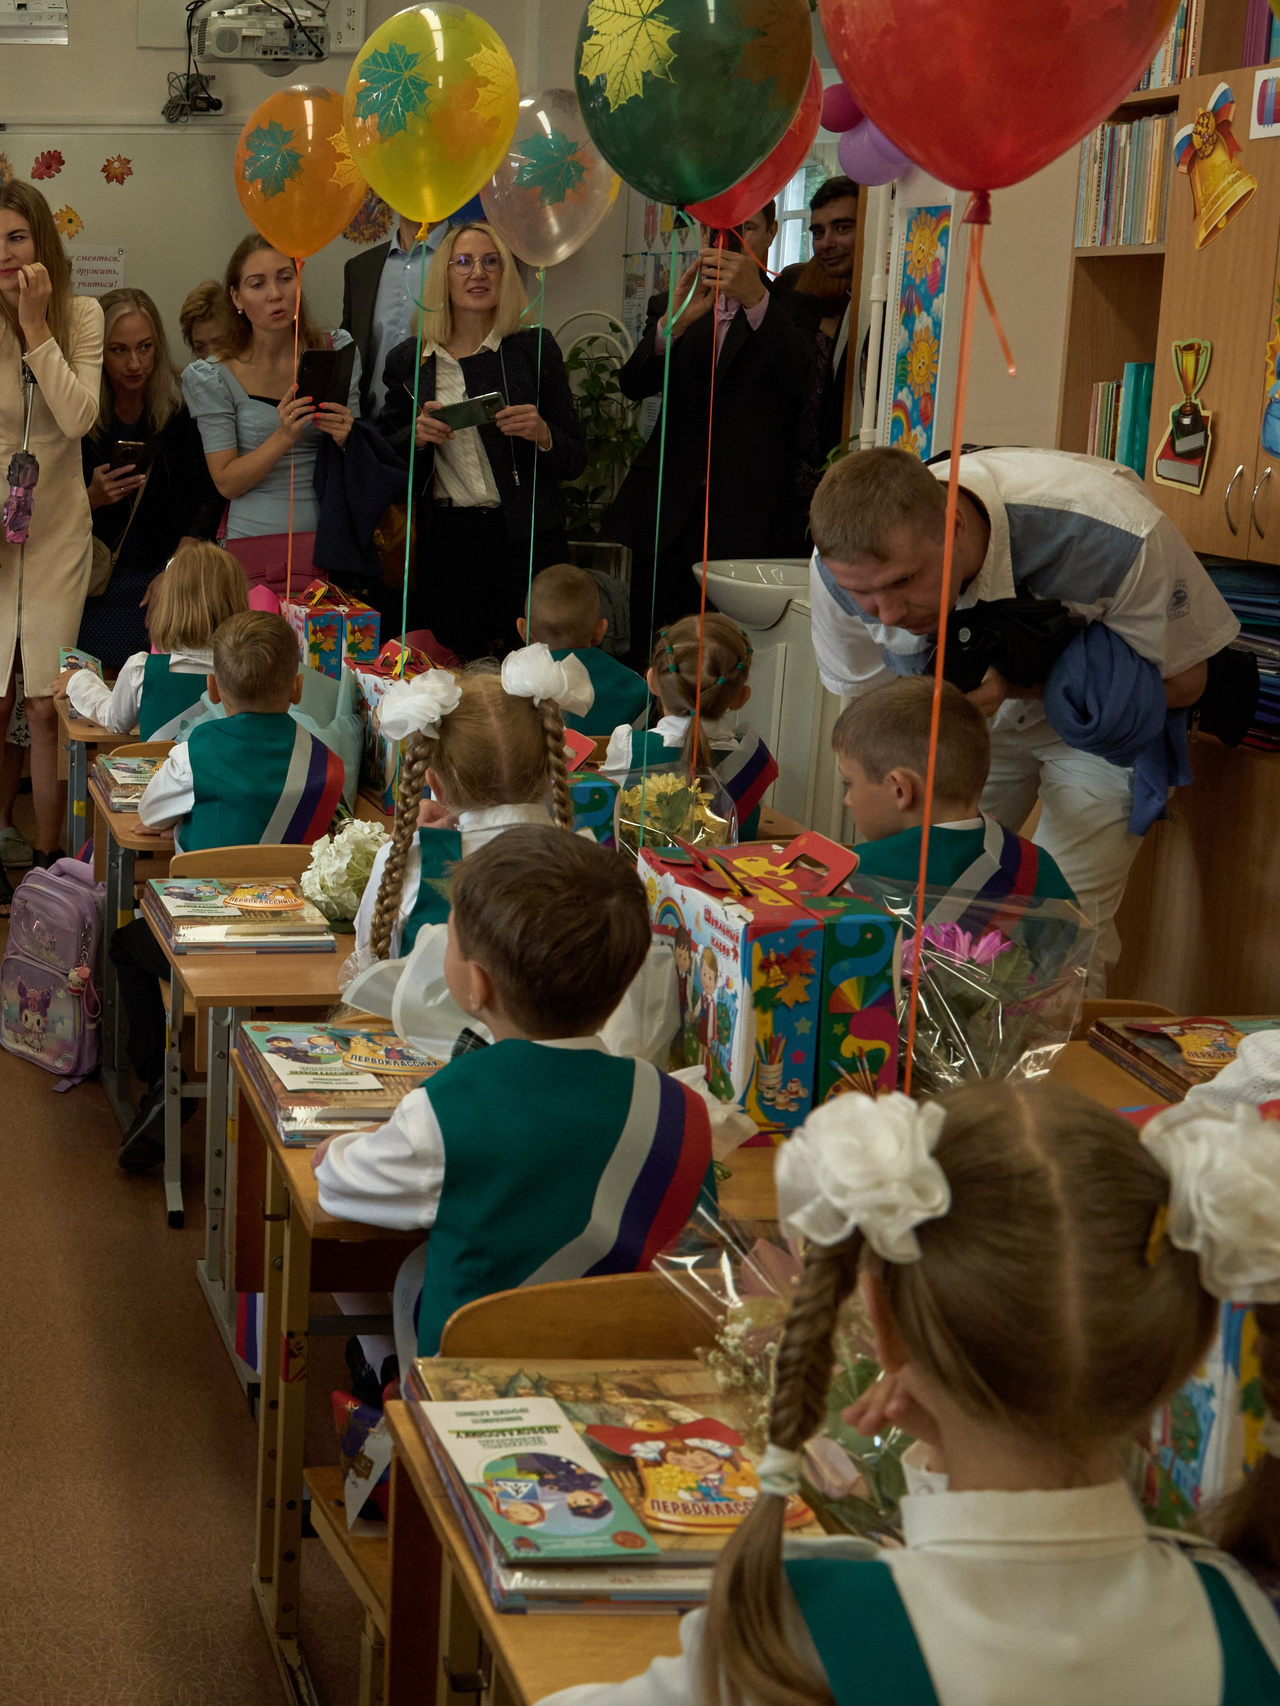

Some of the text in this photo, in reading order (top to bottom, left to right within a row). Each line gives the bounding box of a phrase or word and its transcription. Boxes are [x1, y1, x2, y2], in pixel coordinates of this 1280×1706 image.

[76, 255, 120, 263] смеяться,
[76, 267, 120, 277] дружить,
[76, 280, 118, 289] учиться!
[229, 896, 300, 905] ПЕРВОКЛАССНИЦА
[350, 1053, 440, 1067] ПЕРВОКЛАССНИК
[1187, 1051, 1237, 1060] ПЕРВОКЛ
[650, 1498, 755, 1517] ПЕРВОКЛАСС
